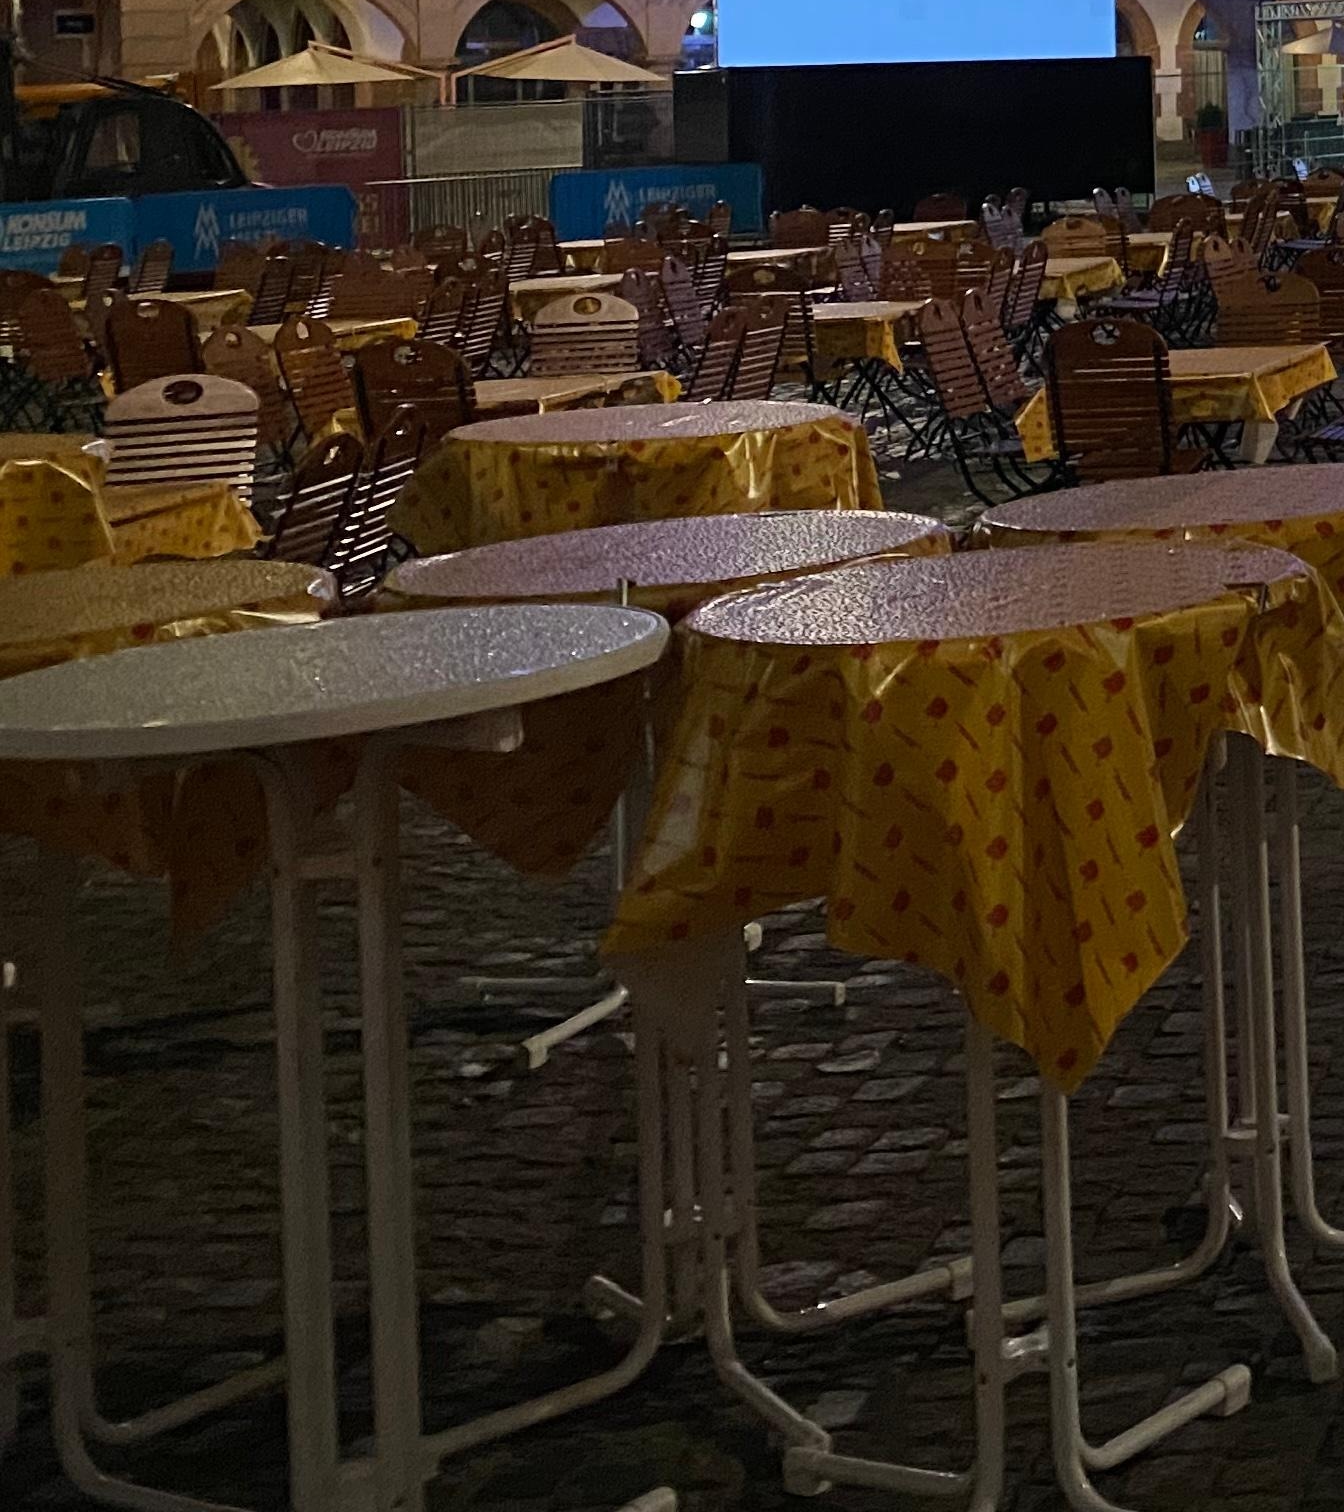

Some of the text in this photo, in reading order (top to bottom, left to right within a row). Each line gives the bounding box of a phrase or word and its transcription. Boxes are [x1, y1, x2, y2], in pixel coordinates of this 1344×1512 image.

[639, 183, 717, 202] LEIPZIGER
[6, 209, 88, 235] KONSUM
[229, 207, 309, 230] LEIPZIGER
[1, 232, 71, 253] LEIPZIG
